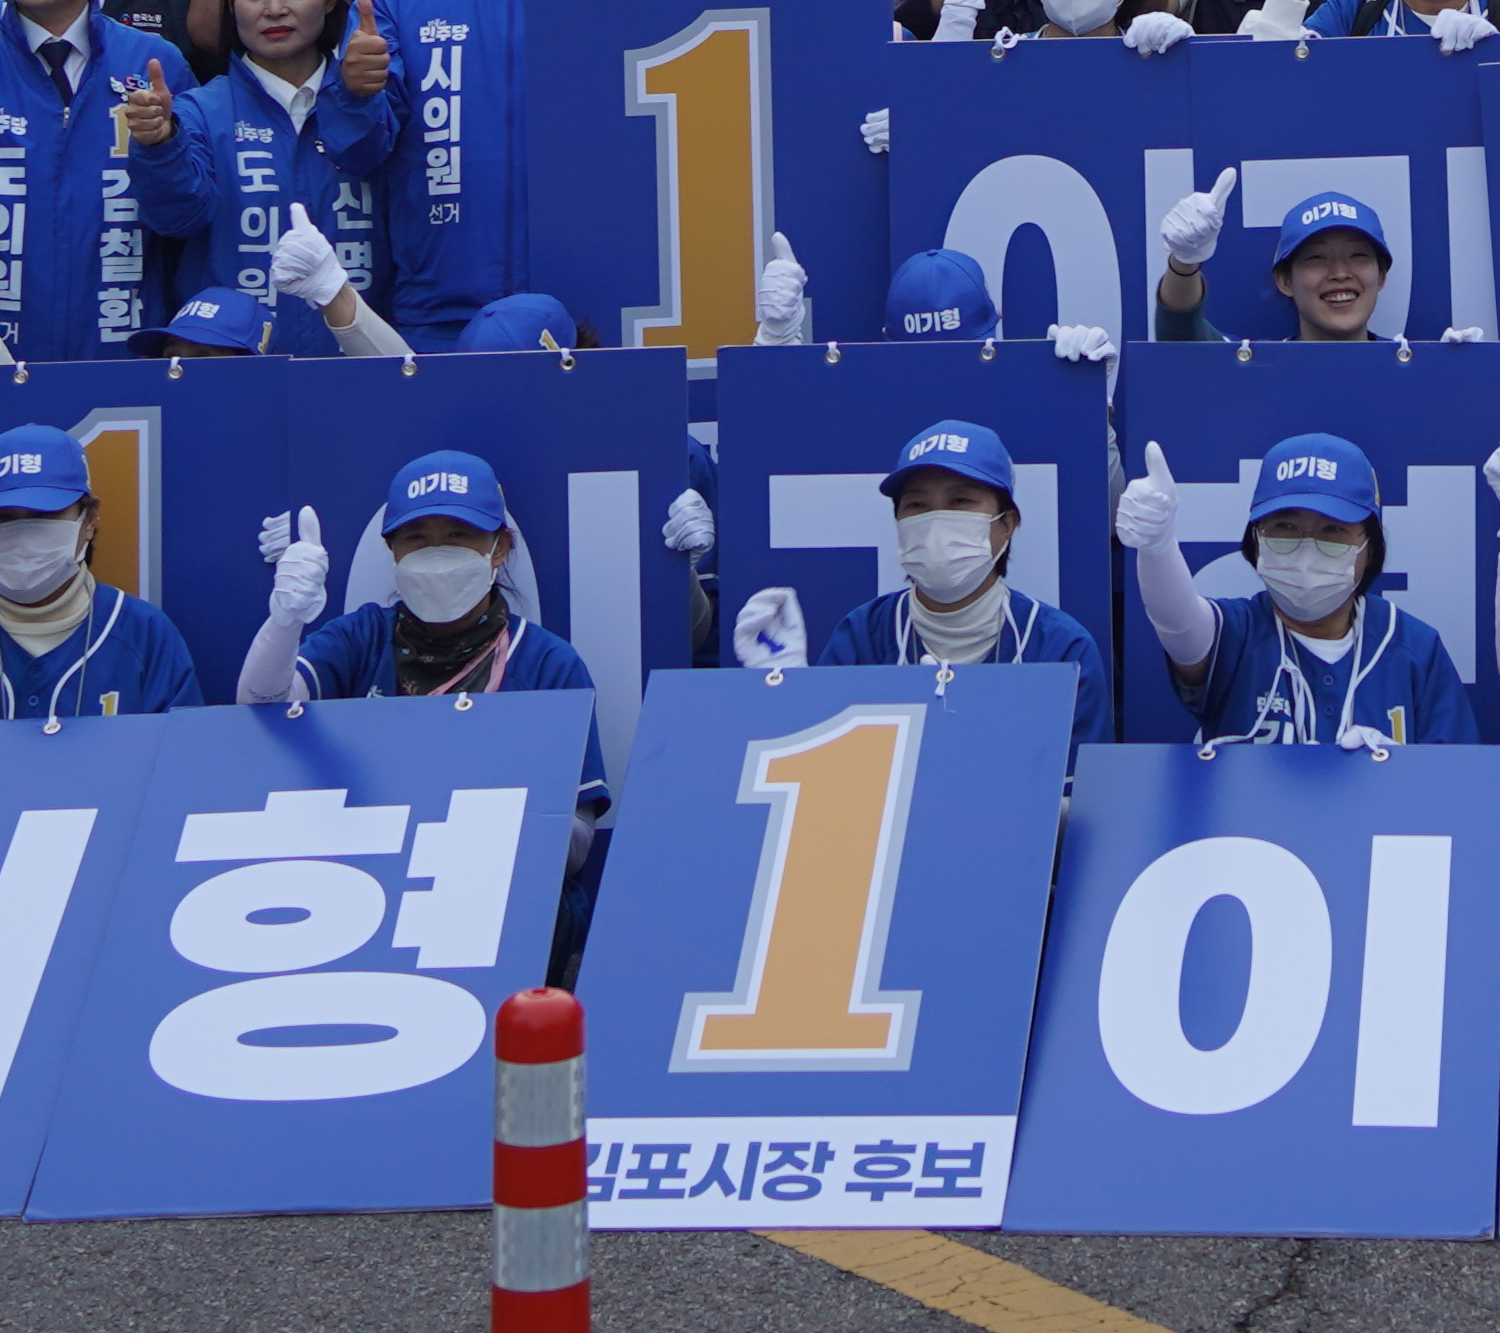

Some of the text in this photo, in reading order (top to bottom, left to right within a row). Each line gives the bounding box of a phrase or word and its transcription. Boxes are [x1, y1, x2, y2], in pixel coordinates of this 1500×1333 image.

[419, 25, 469, 44] 민주당
[420, 44, 462, 197] 시의원
[621, 7, 812, 381] 1
[427, 202, 460, 225] 선거
[1301, 202, 1359, 227] 이기형
[98, 169, 143, 344] 김철환
[902, 307, 962, 335] 이기형
[908, 432, 970, 461] 이기형
[1275, 455, 1338, 484] 이기형
[406, 470, 470, 499] 이기형
[666, 703, 929, 1073] 1
[588, 1136, 989, 1204] 김포시장 후보
